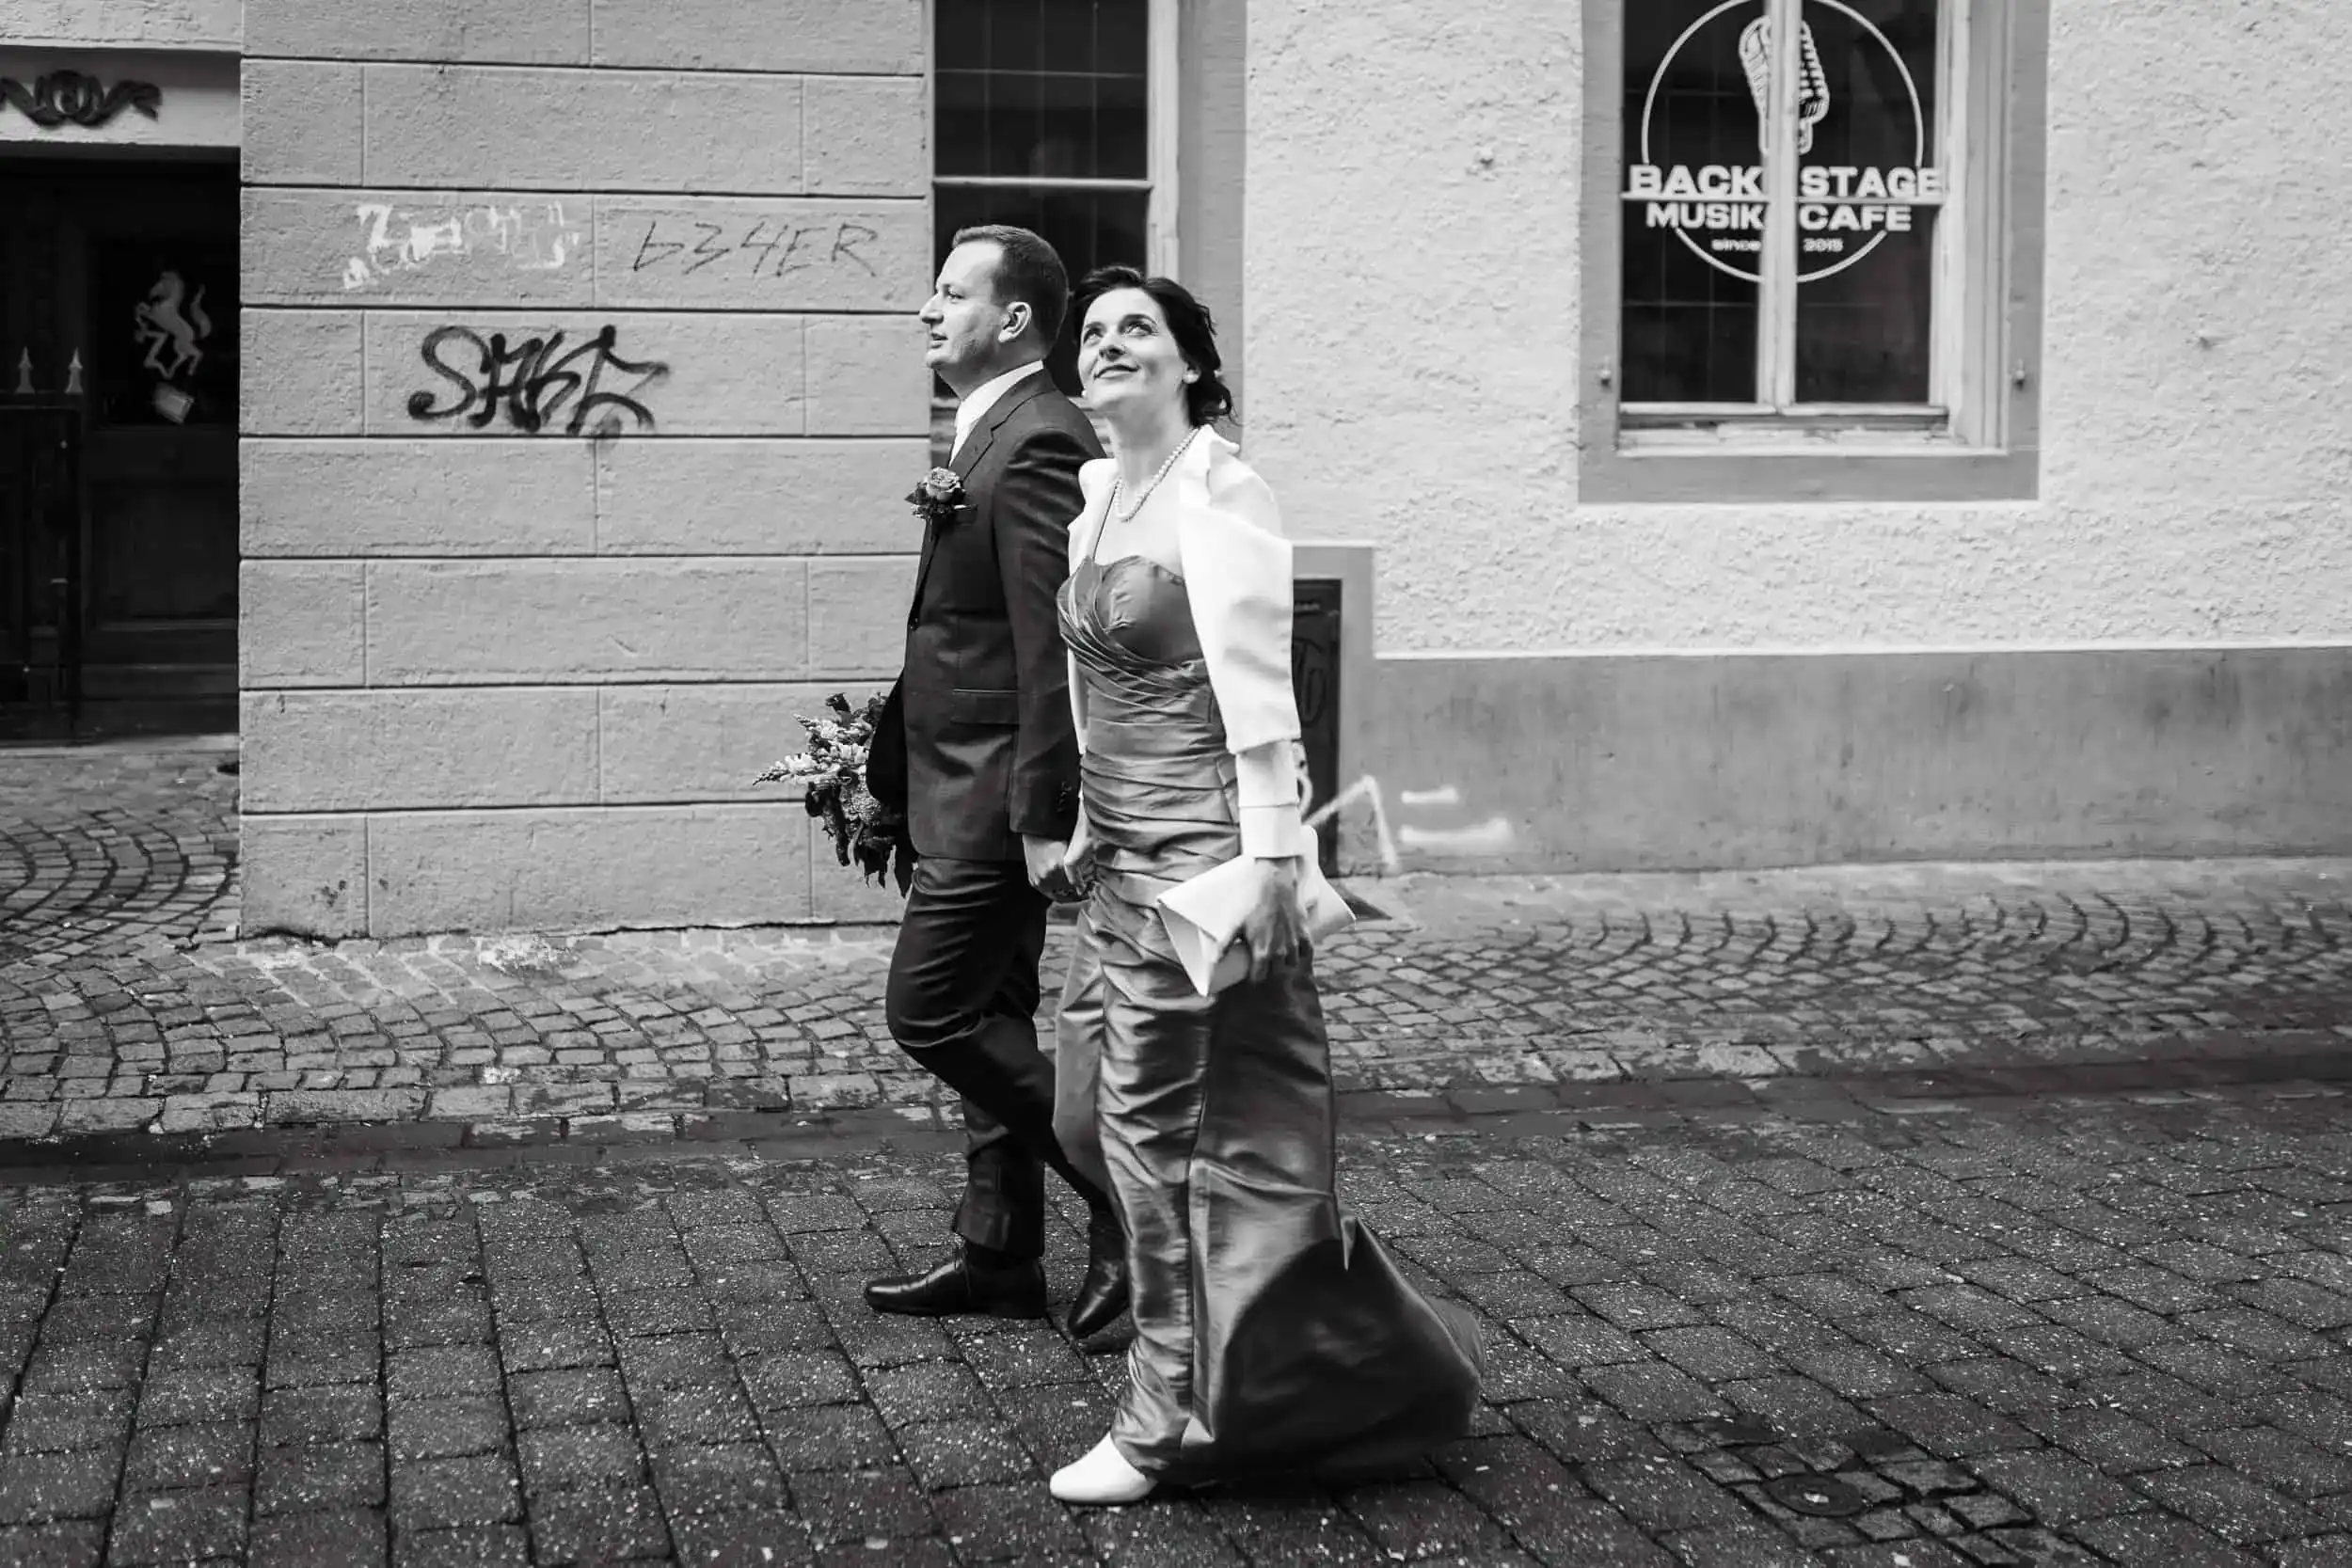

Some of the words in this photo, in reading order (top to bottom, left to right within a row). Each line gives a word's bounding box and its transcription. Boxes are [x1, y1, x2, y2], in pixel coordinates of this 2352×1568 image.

[1629, 165, 1765, 197] BACK
[1801, 166, 1943, 197] STAGE
[1646, 202, 1765, 230] MUSIK
[1799, 204, 1912, 231] CAFE
